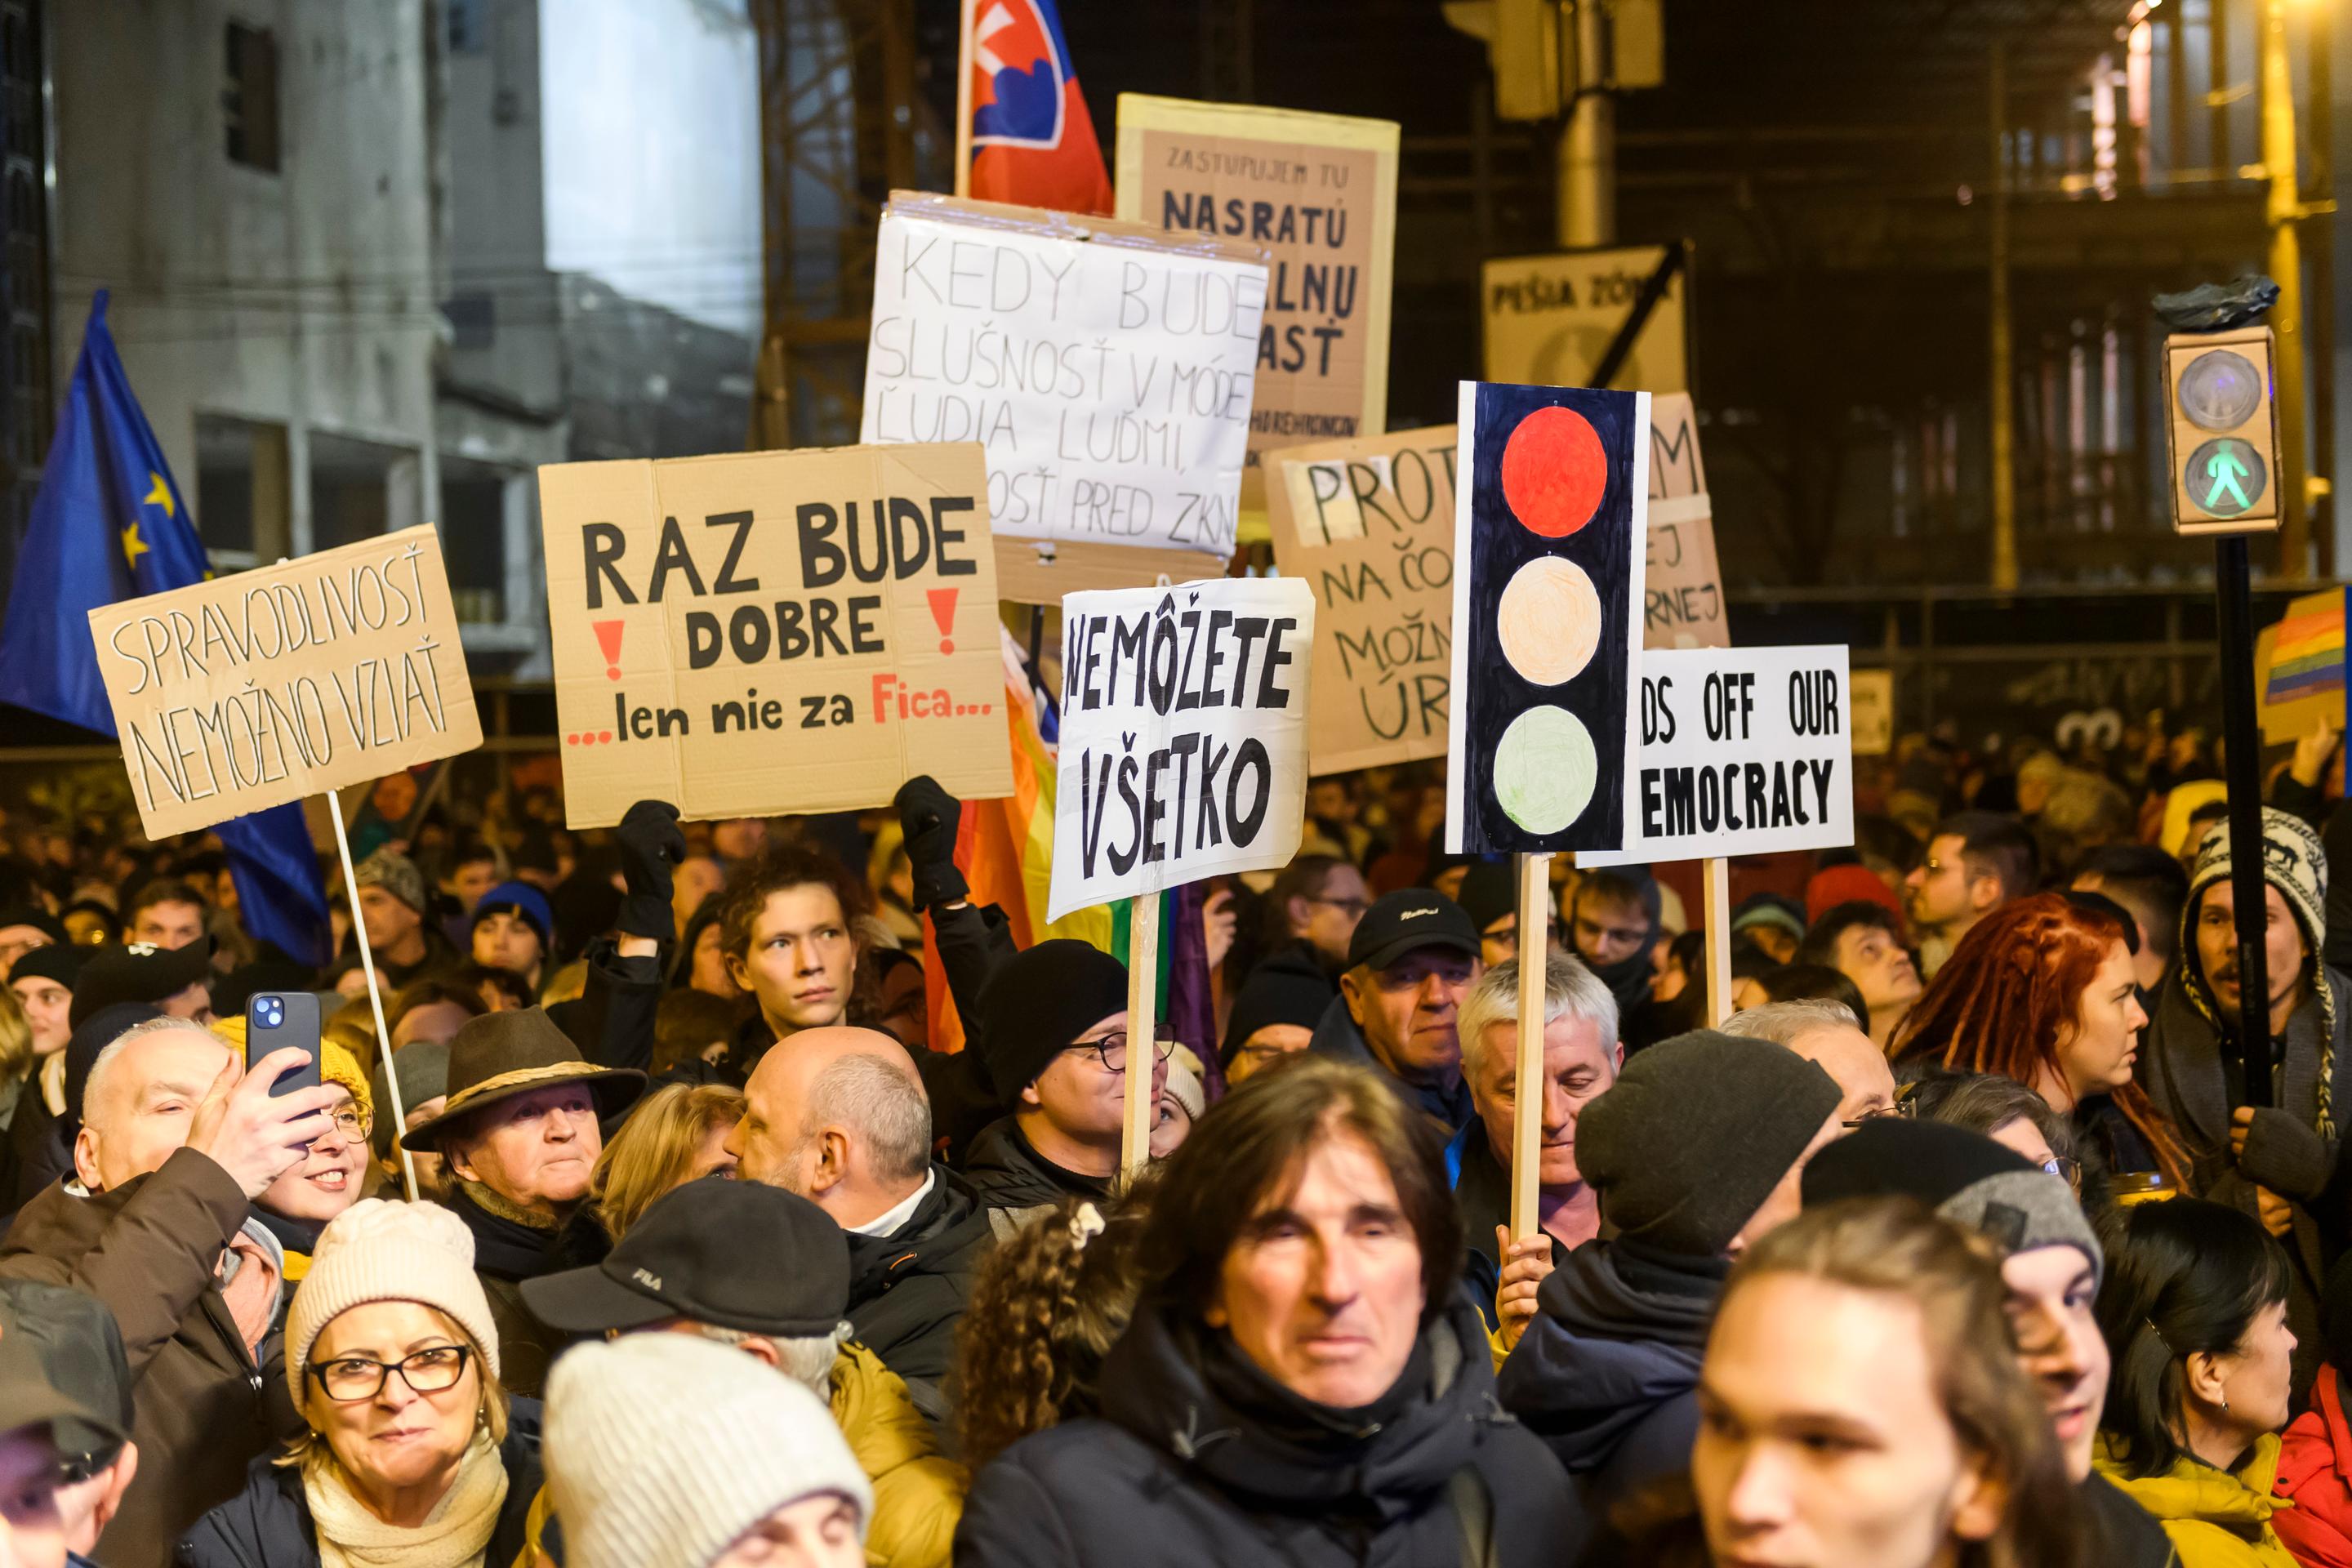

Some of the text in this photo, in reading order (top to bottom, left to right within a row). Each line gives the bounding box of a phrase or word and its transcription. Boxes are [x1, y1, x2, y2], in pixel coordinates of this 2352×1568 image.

[1168, 147, 1349, 189] ZASTUPUJEM TU
[1163, 190, 1346, 248] NASRATÚ
[902, 234, 1266, 340] KEDY BUDE
[1264, 261, 1357, 319] LNU
[875, 316, 1116, 402] SLUŠNOSŤ
[1130, 352, 1158, 408] V
[1255, 318, 1344, 376] ASŤ
[987, 466, 1057, 523] OSŤ
[1071, 479, 1154, 537] PRED
[1307, 418, 1699, 546] PROT M
[581, 496, 977, 609] RAZ BUDE
[1321, 561, 1392, 609] NA
[1392, 537, 1454, 592] ČO
[109, 541, 426, 694] SPRAVODLIVOSŤ
[686, 595, 884, 670] DOBRE
[1064, 591, 1297, 716] NEMÔŽETE
[1334, 582, 1719, 680] MOŽN RNEJ
[127, 635, 447, 812] NEMOŽNO VZIAŤ
[711, 688, 782, 733] nie
[800, 694, 853, 728] za
[872, 673, 992, 724] Fica...
[1360, 671, 1450, 740] ÚR
[1640, 669, 1839, 746] DS OFF OUR
[1081, 730, 1272, 880] VŠETKO
[1640, 759, 1833, 838] EMOCRACY
[632, 1267, 662, 1291] FILA
